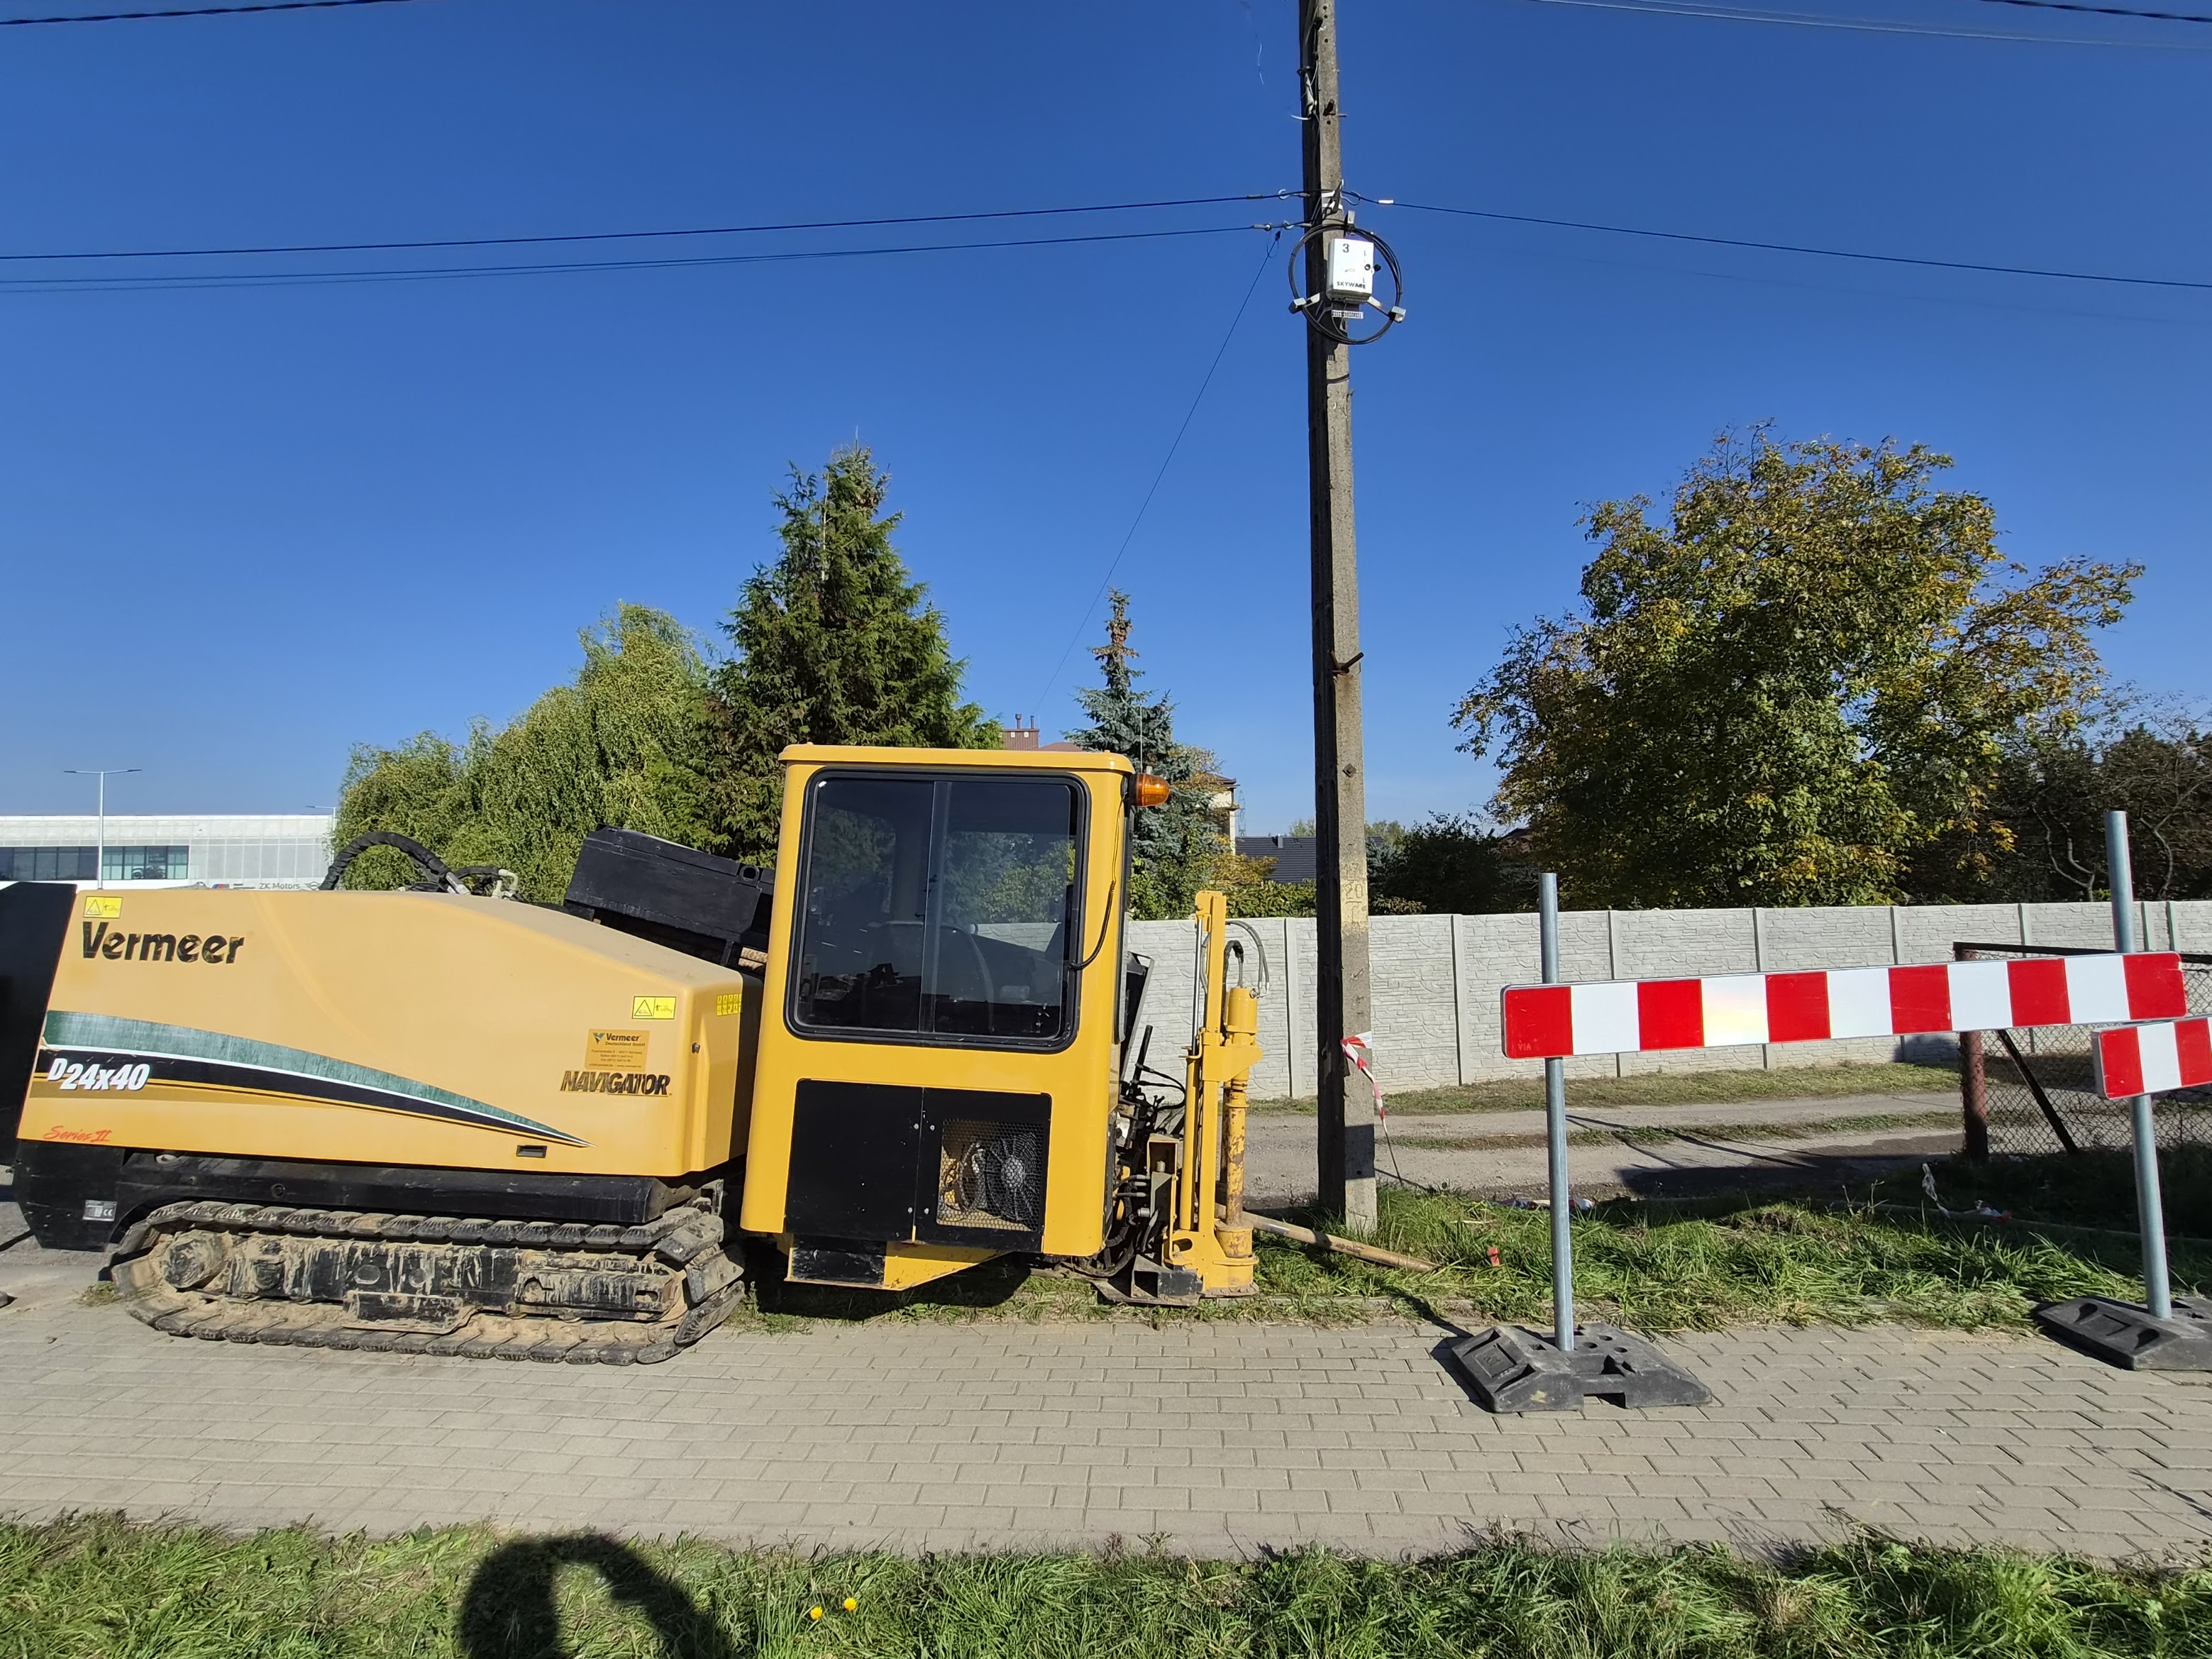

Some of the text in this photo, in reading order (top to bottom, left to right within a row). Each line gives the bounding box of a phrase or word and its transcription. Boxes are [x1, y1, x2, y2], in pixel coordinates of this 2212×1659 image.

[1342, 243, 1349, 253] 3
[82, 921, 245, 964] Vermeer
[606, 1032, 641, 1042] Vermeer
[47, 1058, 151, 1091] D24x40
[560, 1071, 671, 1095] NAVIGATOR
[43, 1125, 113, 1142] Series II
